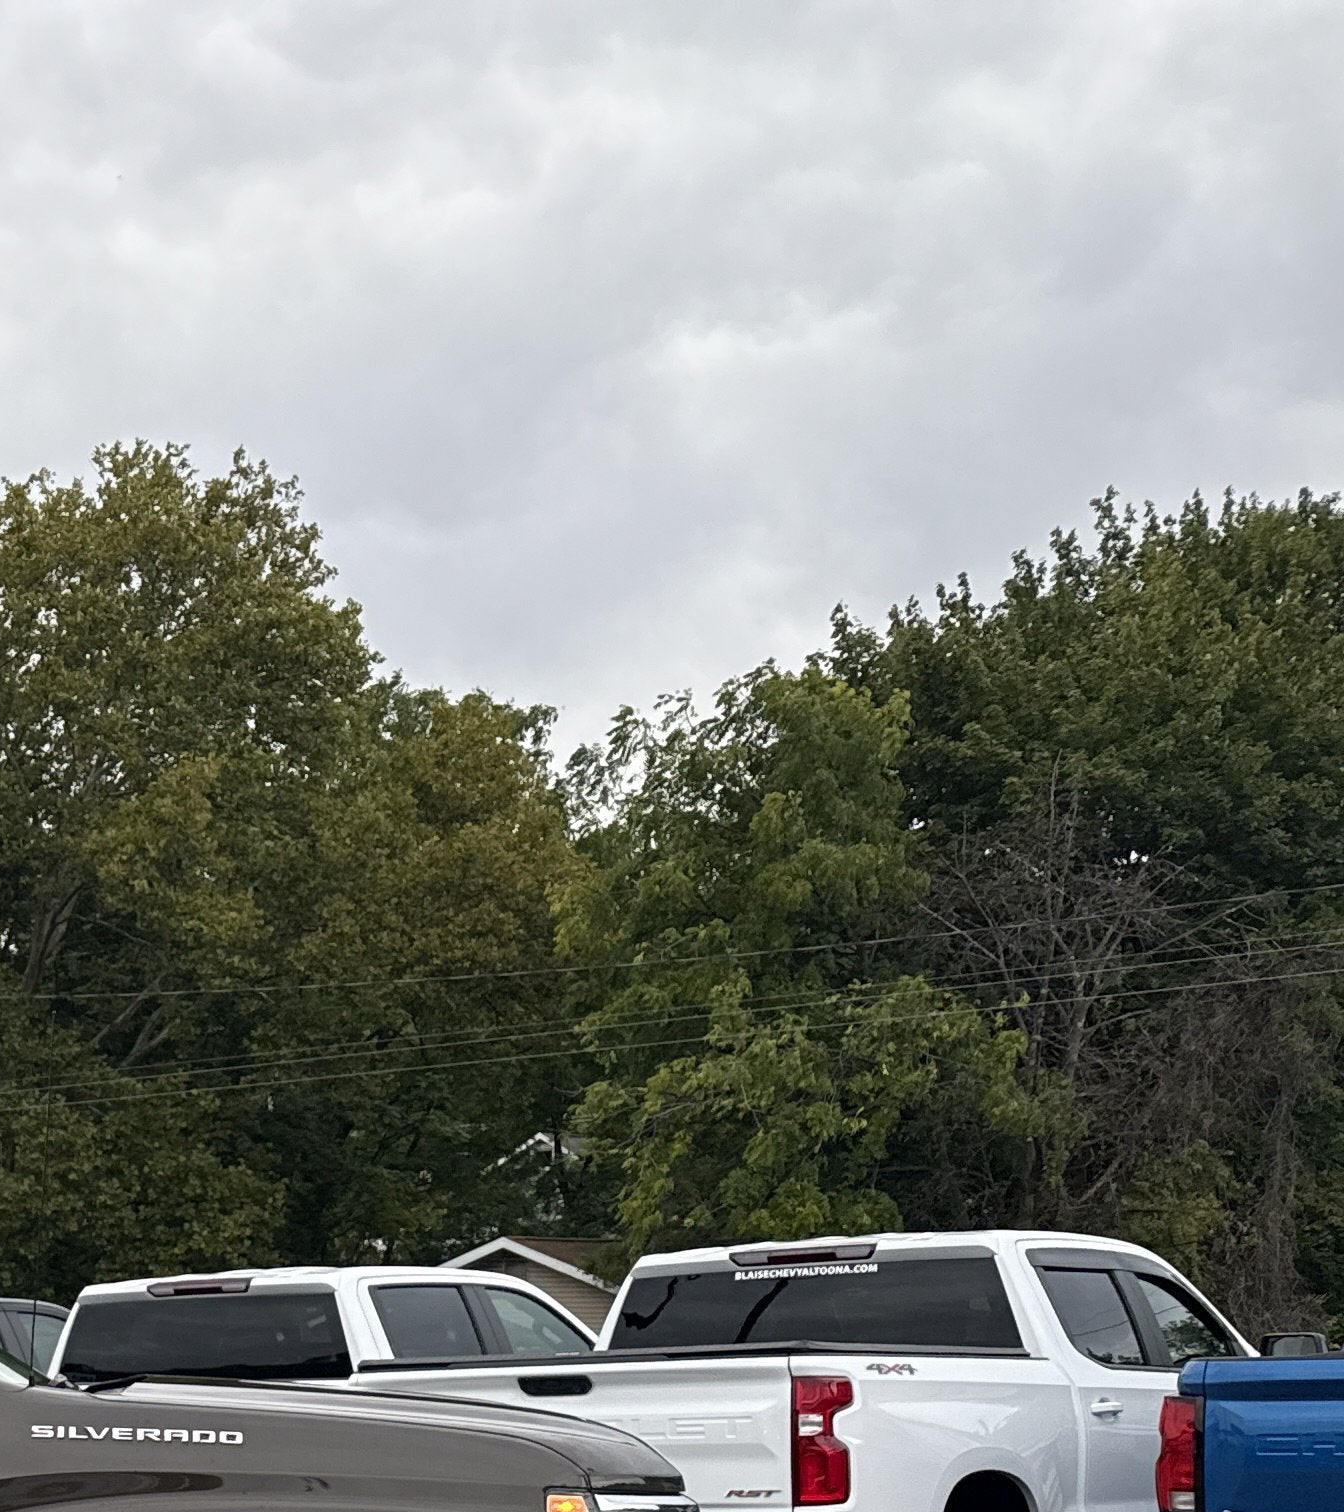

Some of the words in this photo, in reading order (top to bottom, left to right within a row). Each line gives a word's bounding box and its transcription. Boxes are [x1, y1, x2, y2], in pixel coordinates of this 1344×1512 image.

[734, 1263, 878, 1281] BLAISECHEVYALTOONA.COM
[31, 1425, 244, 1445] SILVERADO
[725, 1489, 782, 1499] RST
